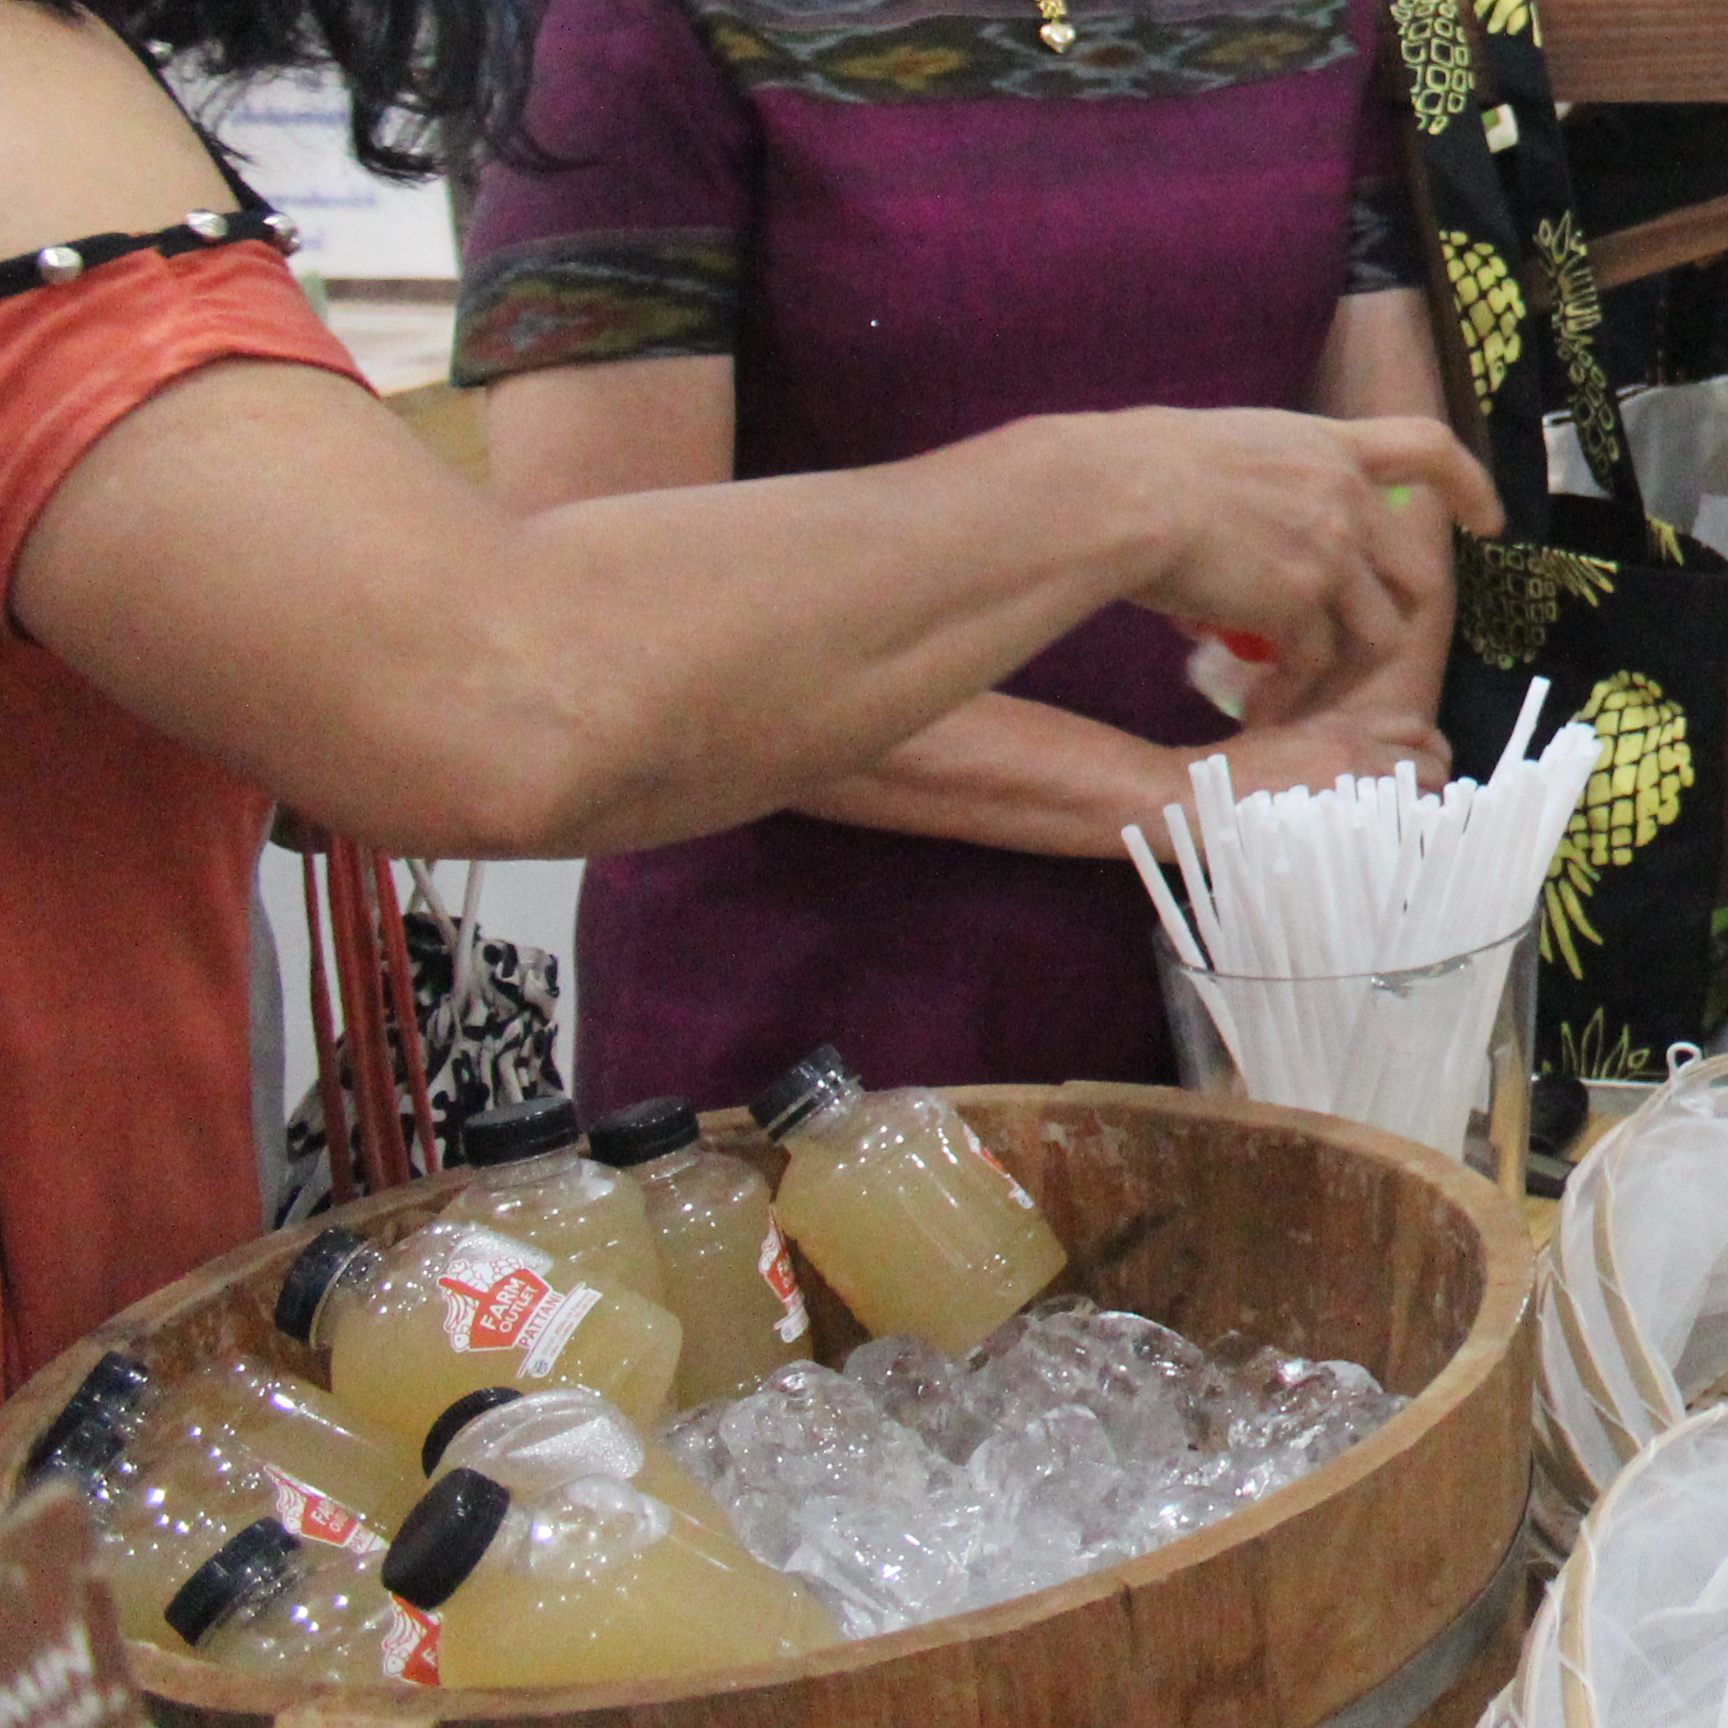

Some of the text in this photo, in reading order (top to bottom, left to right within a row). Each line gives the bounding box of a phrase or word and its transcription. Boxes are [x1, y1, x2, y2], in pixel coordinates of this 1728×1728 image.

[480, 1276, 527, 1331] FARM
[499, 1285, 539, 1333] OUTLET
[518, 1292, 564, 1349] PATTANI
